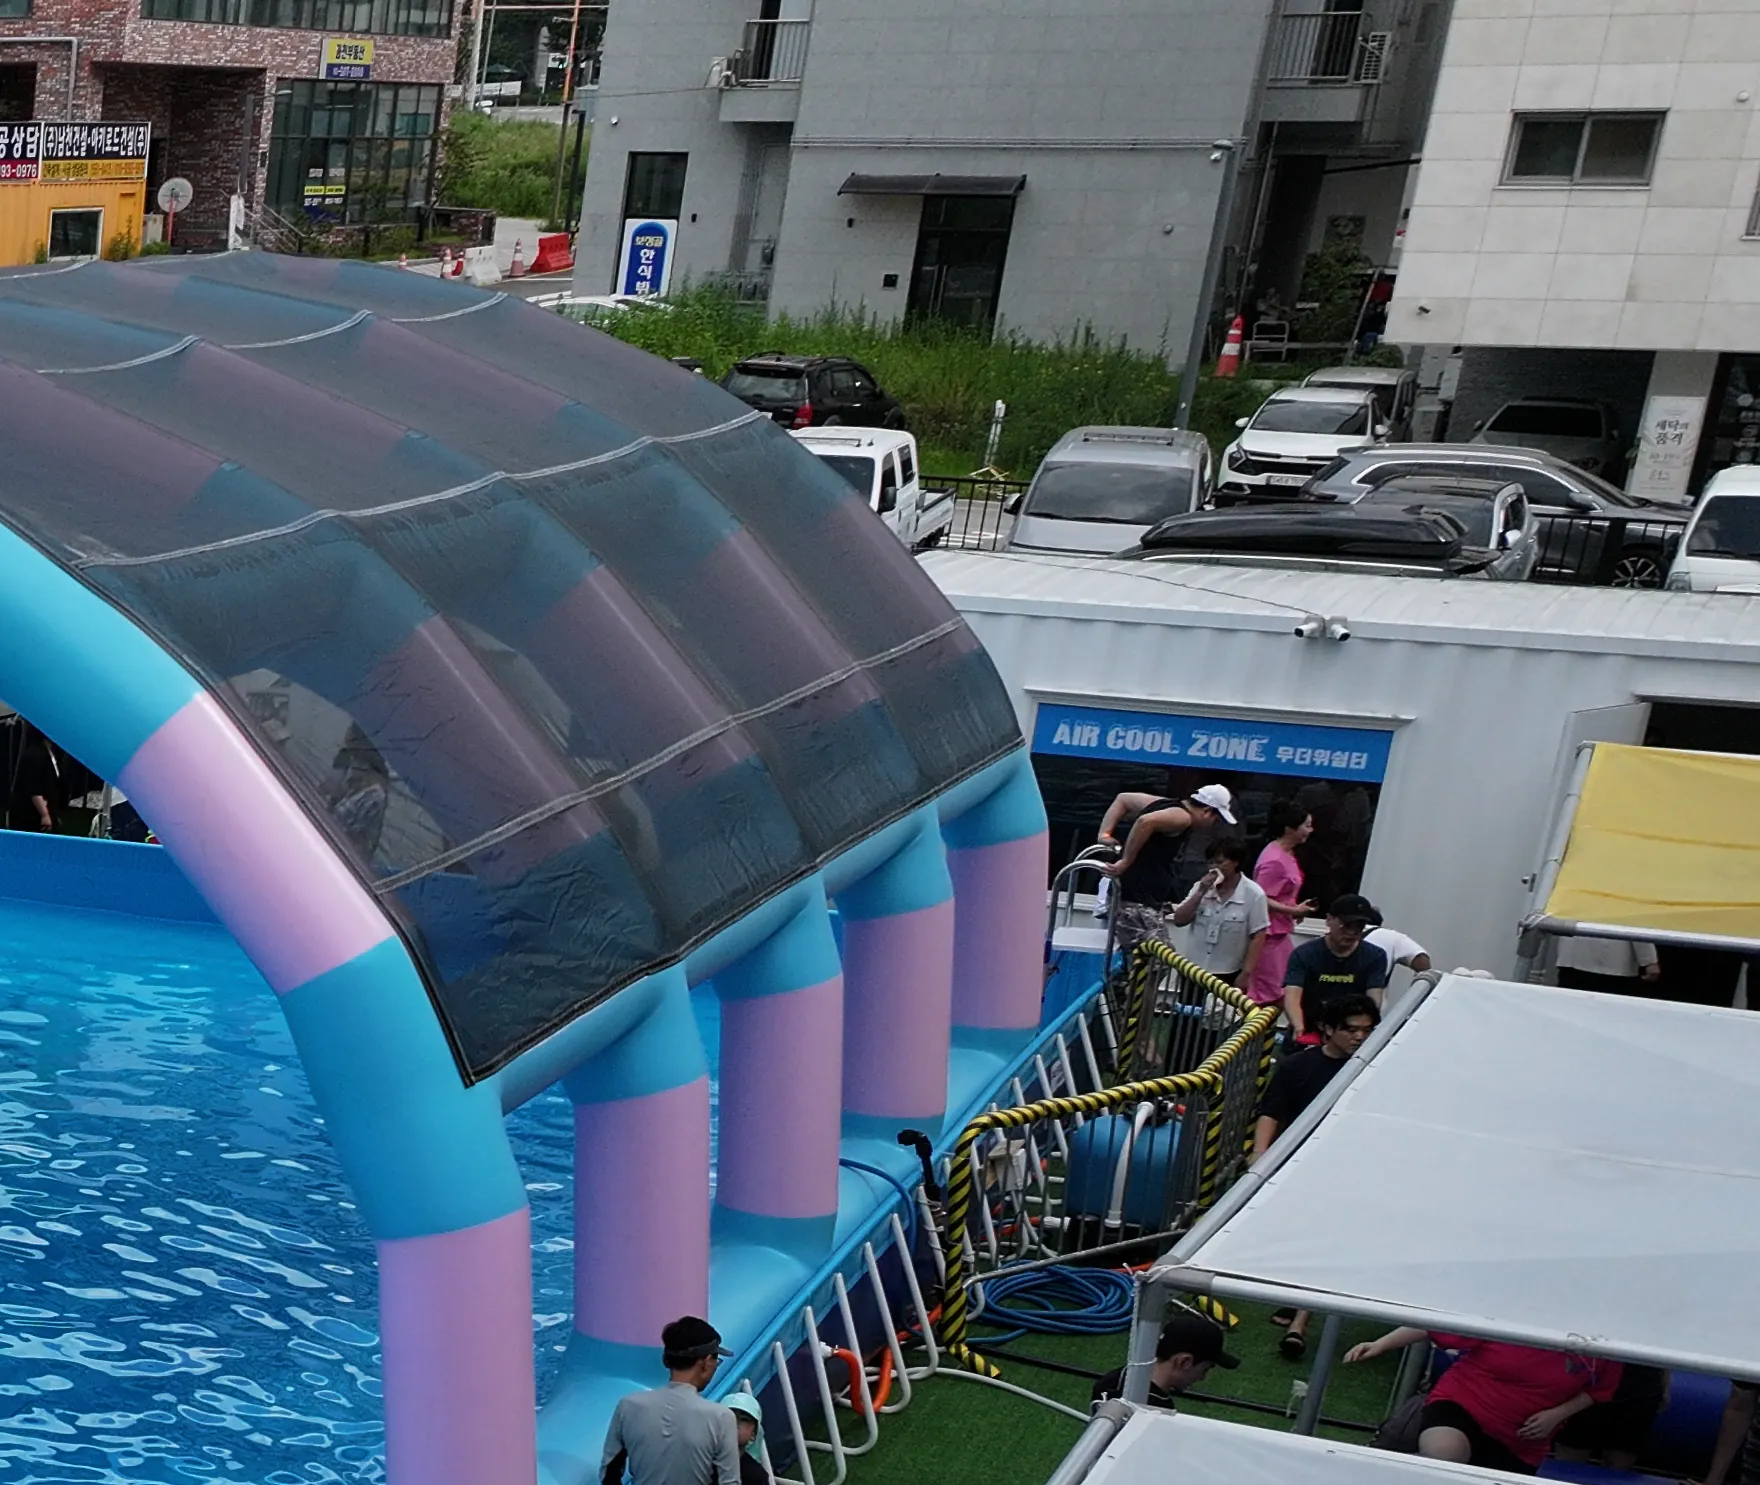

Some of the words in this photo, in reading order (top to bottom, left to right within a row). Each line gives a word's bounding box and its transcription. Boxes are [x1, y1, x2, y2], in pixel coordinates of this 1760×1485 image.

[1053, 719, 1100, 748] AIR
[1106, 725, 1180, 755] COOL
[1187, 730, 1271, 762] ZONE
[1275, 745, 1369, 770] 무더위쉼터
